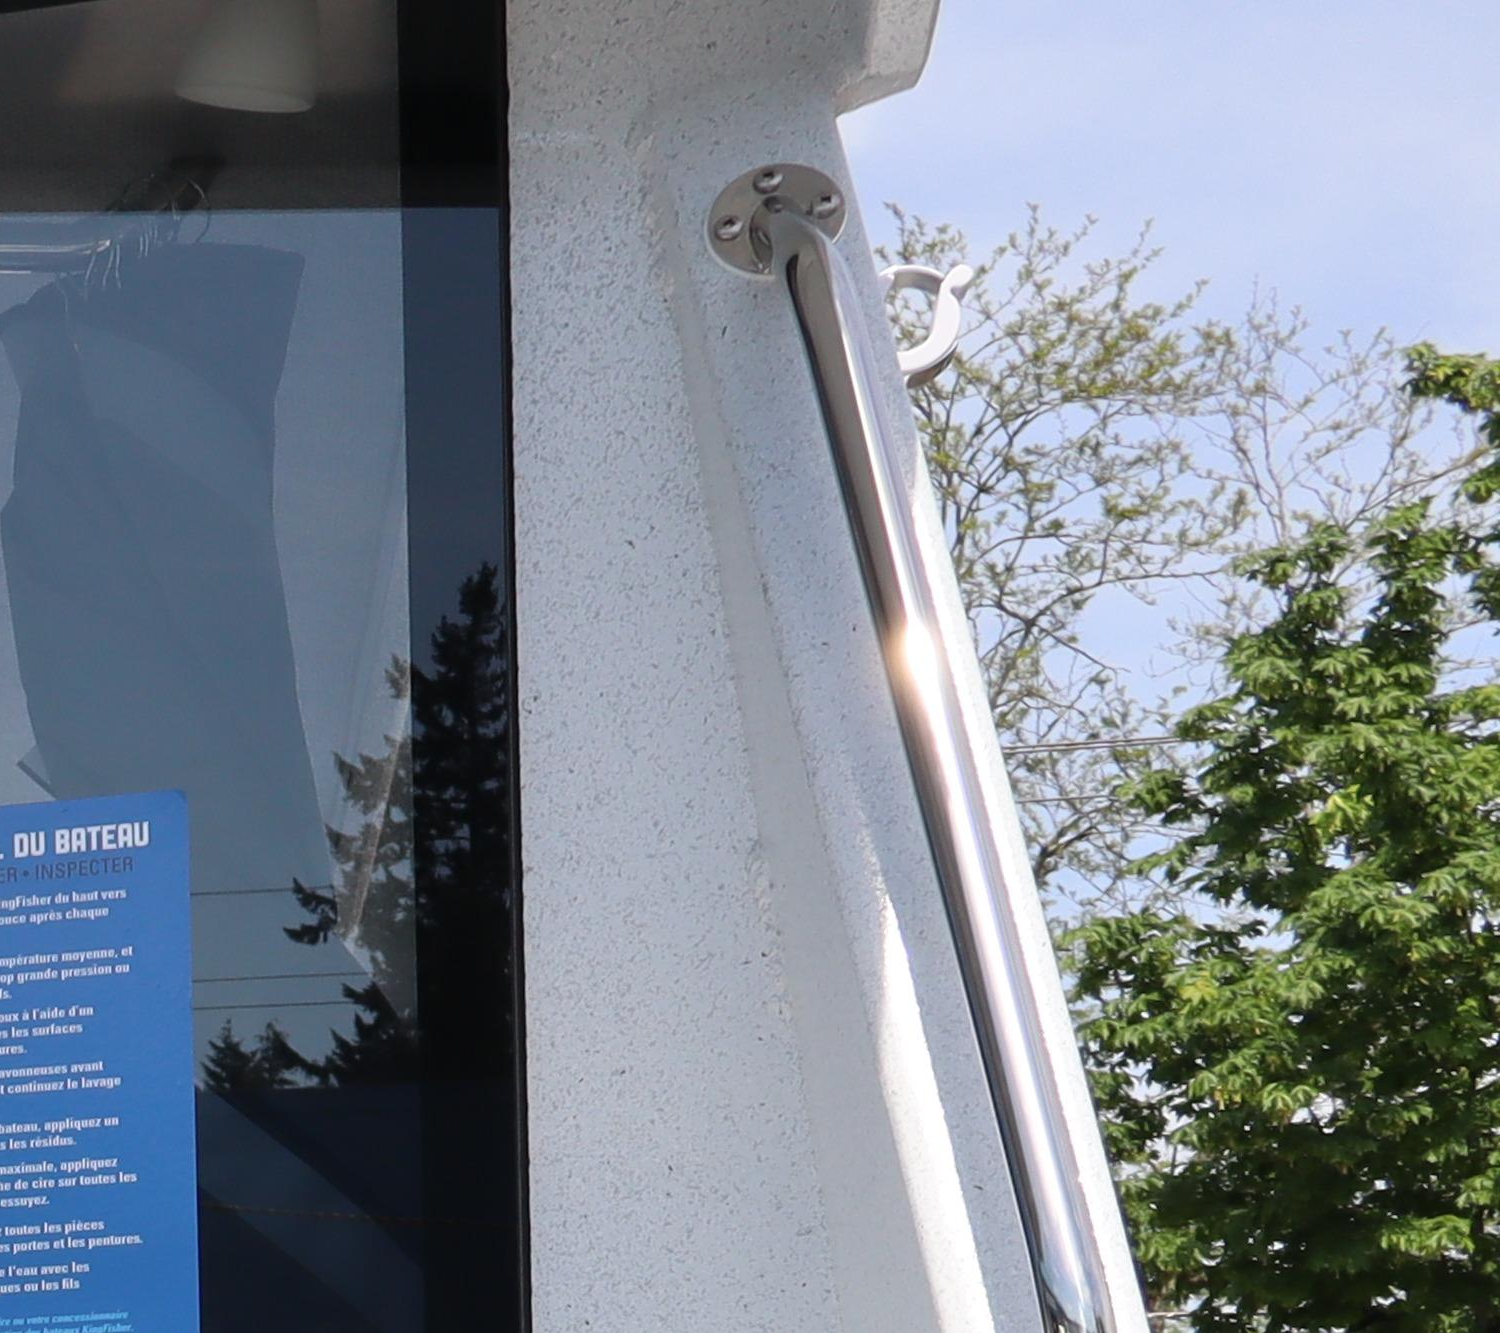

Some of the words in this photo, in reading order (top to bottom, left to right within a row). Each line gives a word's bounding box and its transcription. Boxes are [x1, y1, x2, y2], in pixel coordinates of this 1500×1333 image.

[13, 831, 45, 858] DU
[55, 822, 149, 855] BATEAU
[35, 856, 133, 881] INSPECTER
[16, 967, 57, 985] grande
[61, 963, 111, 981] pression
[114, 964, 129, 974] ou
[11, 1025, 28, 1038] les
[32, 1021, 82, 1036] surfaces
[7, 1079, 64, 1094] continuez
[67, 1078, 78, 1089] le
[81, 1075, 121, 1091] lavage
[9, 1138, 27, 1150] les
[0, 1197, 49, 1211] essuyez.
[23, 1283, 38, 1292] ou
[41, 1279, 59, 1291] les
[61, 1277, 79, 1290] fils
